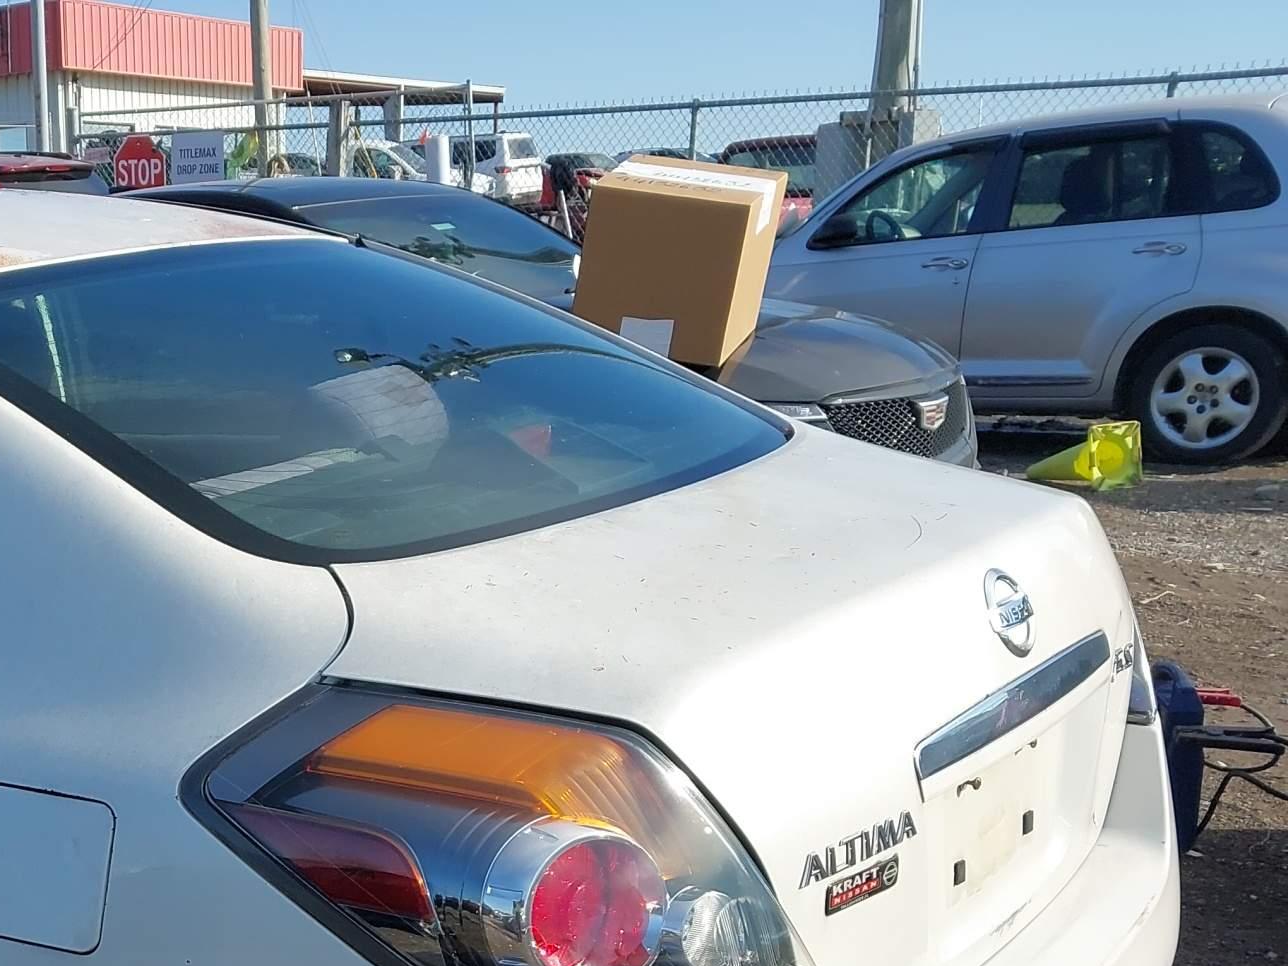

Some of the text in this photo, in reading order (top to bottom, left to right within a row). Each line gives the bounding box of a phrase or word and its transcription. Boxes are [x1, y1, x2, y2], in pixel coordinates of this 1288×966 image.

[179, 147, 217, 159] TITLEMAX
[118, 159, 162, 186] STOP
[176, 163, 220, 176] DROP ZONE
[798, 810, 917, 890] ALTIMA
[831, 866, 881, 896] KRAFT
[833, 880, 878, 905] NISSAN
